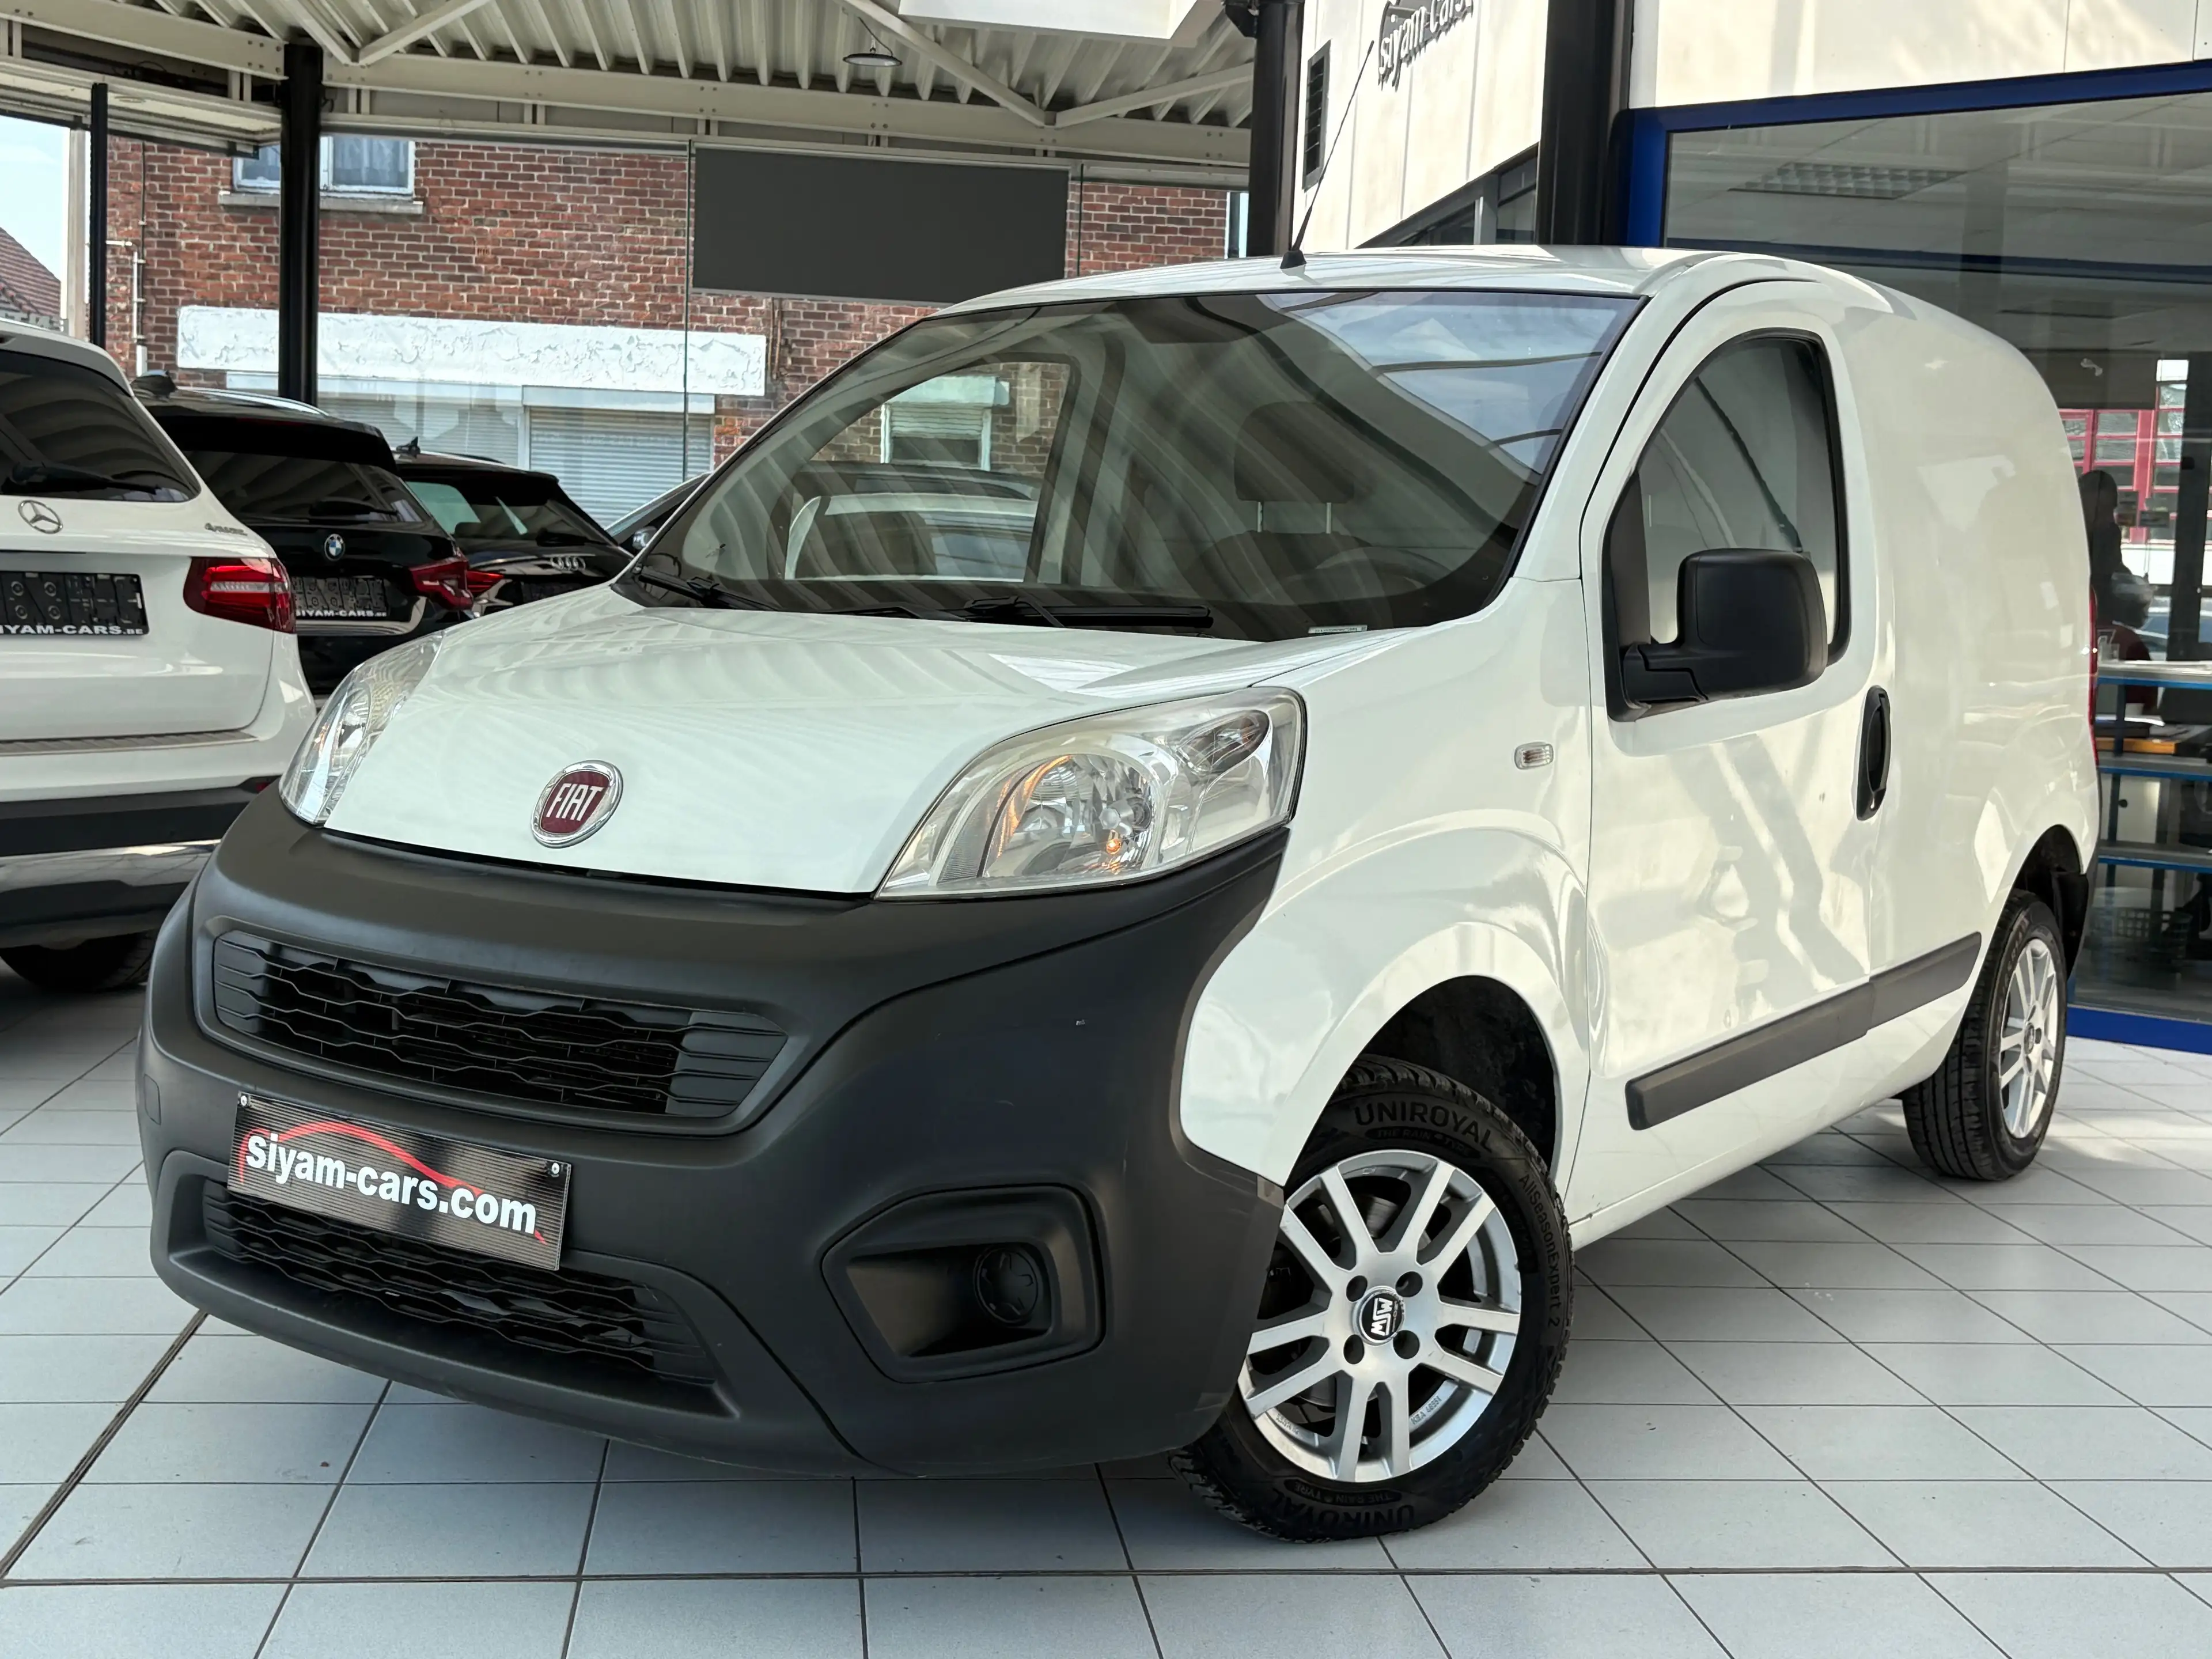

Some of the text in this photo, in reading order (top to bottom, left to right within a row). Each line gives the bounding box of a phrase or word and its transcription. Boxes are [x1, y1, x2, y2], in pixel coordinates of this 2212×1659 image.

[546, 783, 604, 821] FIAT
[1355, 1100, 1493, 1153] UNIROYAL
[246, 1133, 536, 1234] siyam-cars.com
[1519, 1174, 1561, 1327] AllSeasonExpert 2
[1370, 1297, 1393, 1336] MSW
